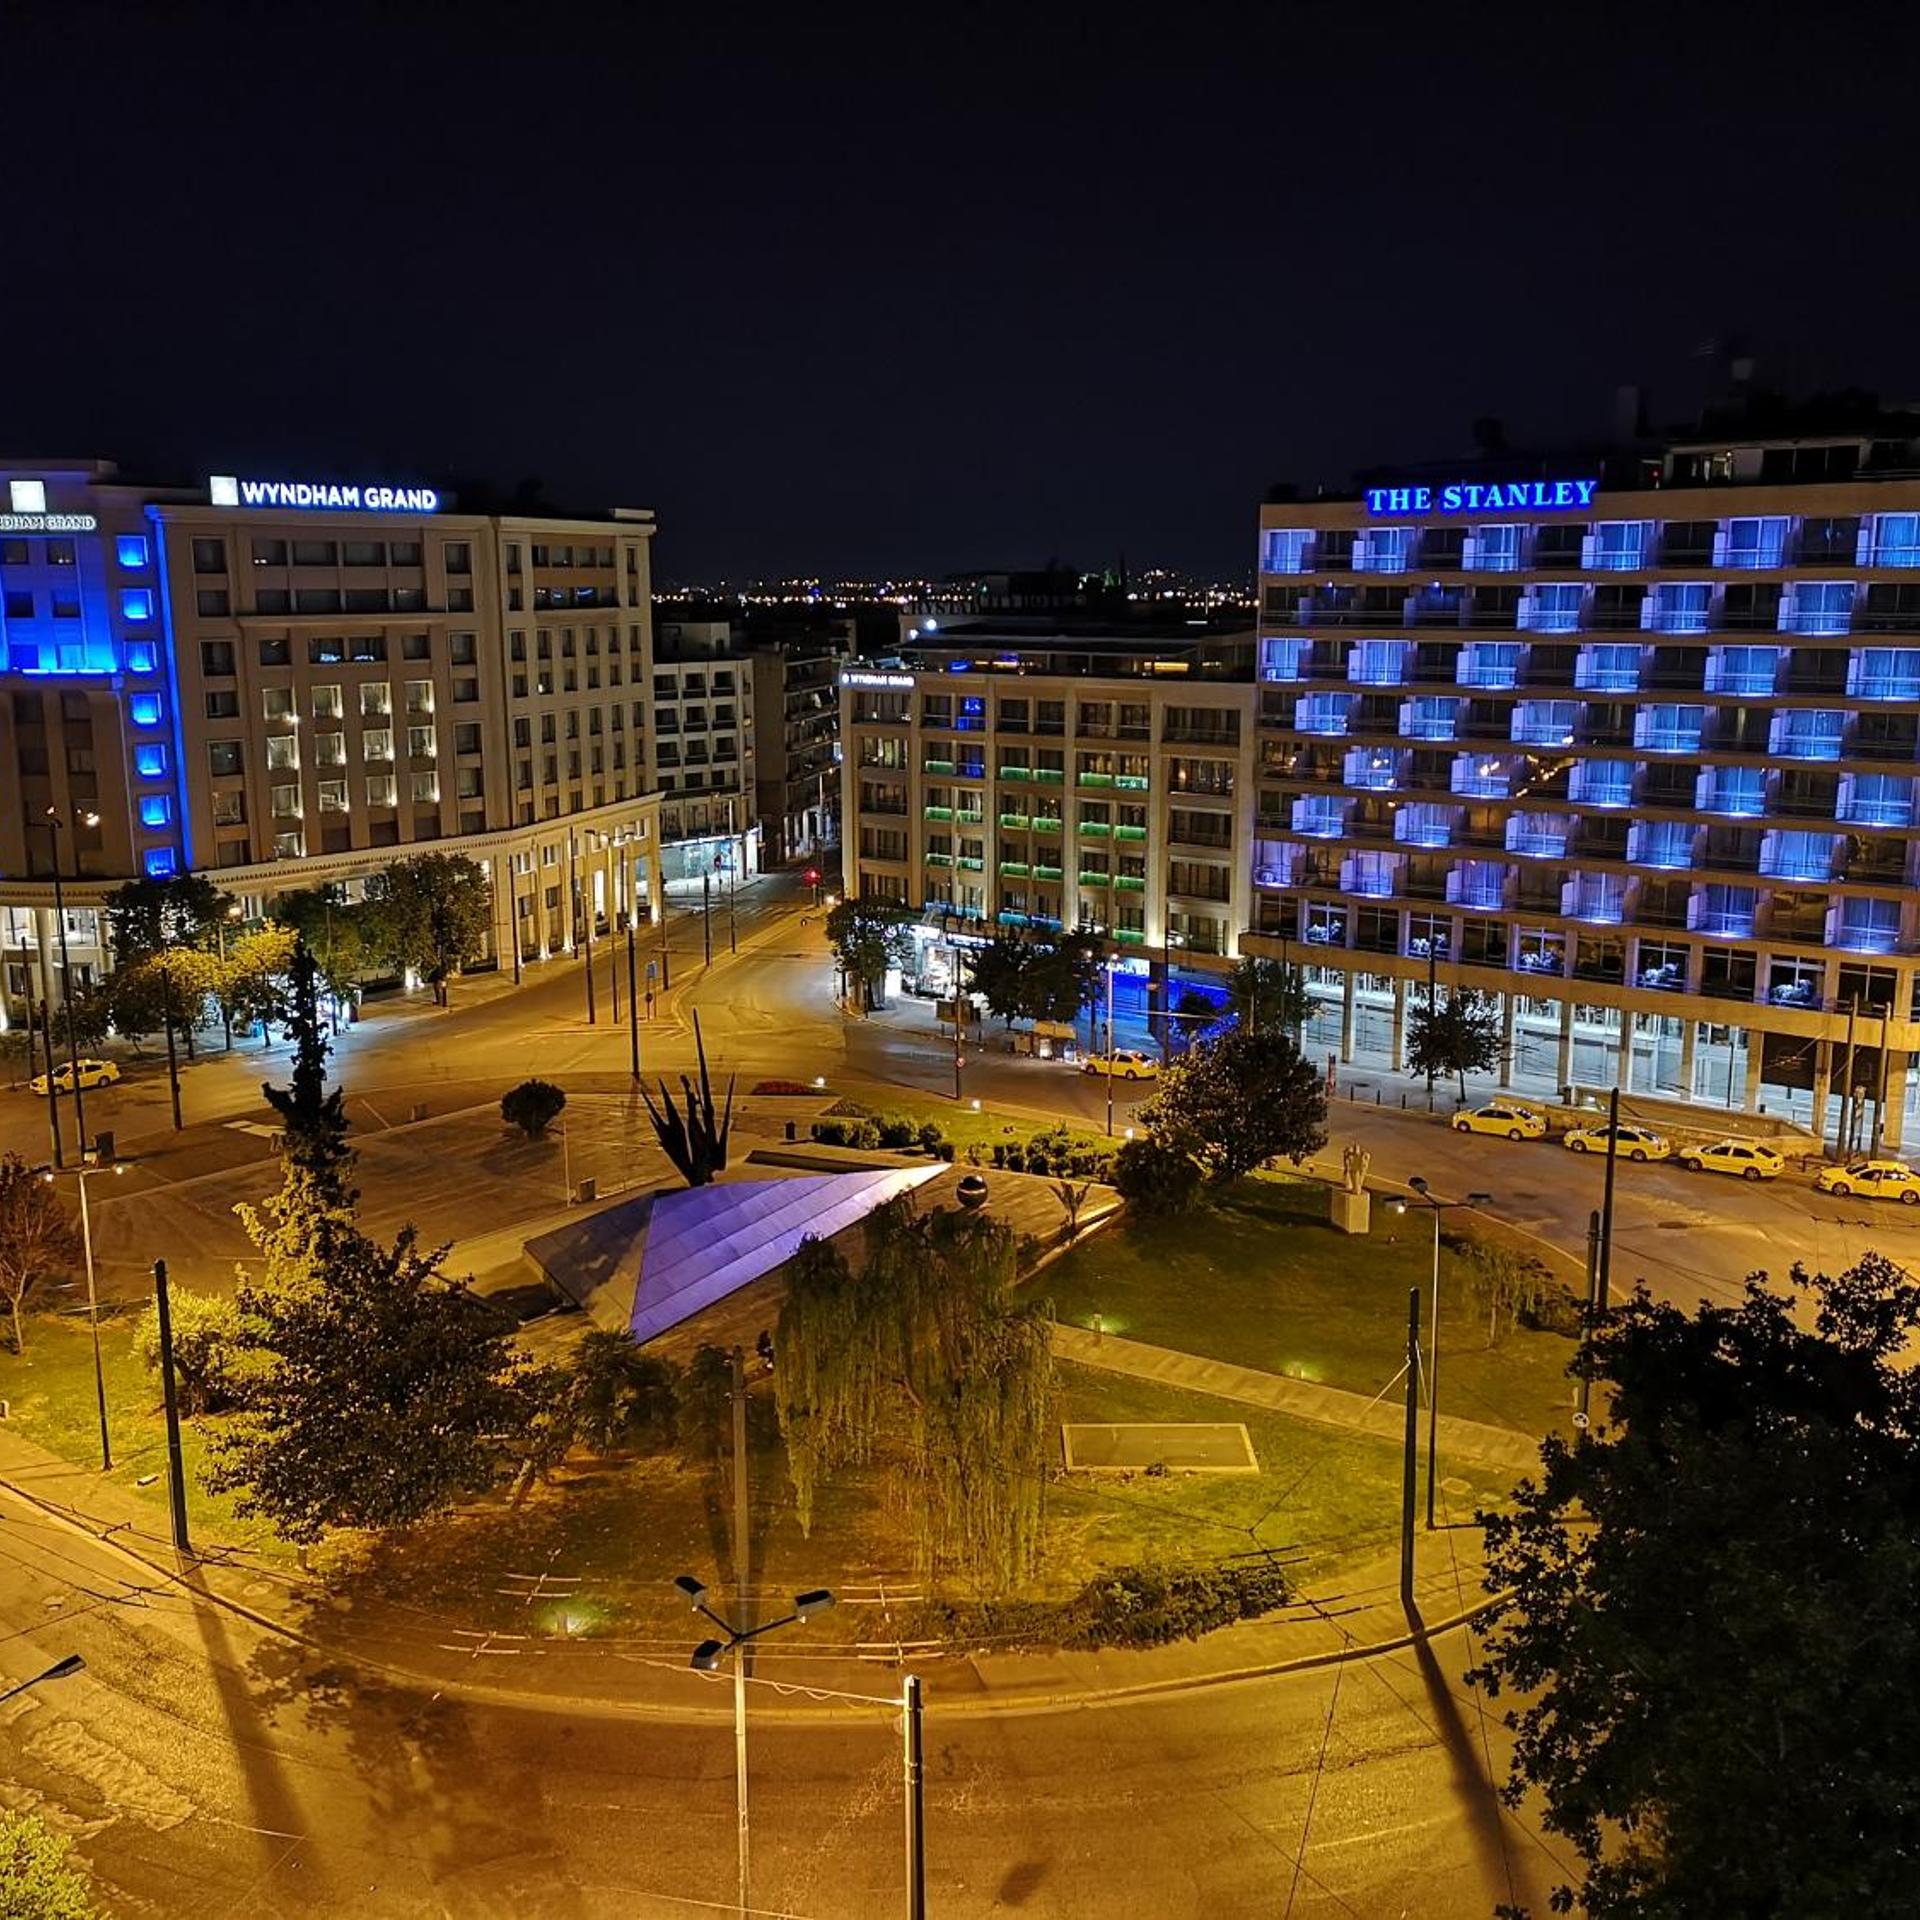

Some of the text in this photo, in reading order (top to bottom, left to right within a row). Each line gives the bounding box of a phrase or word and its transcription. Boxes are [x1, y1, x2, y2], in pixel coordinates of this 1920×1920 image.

[241, 482, 437, 510] WYNDHAM GRAND
[1368, 480, 1597, 511] THE STANLEY
